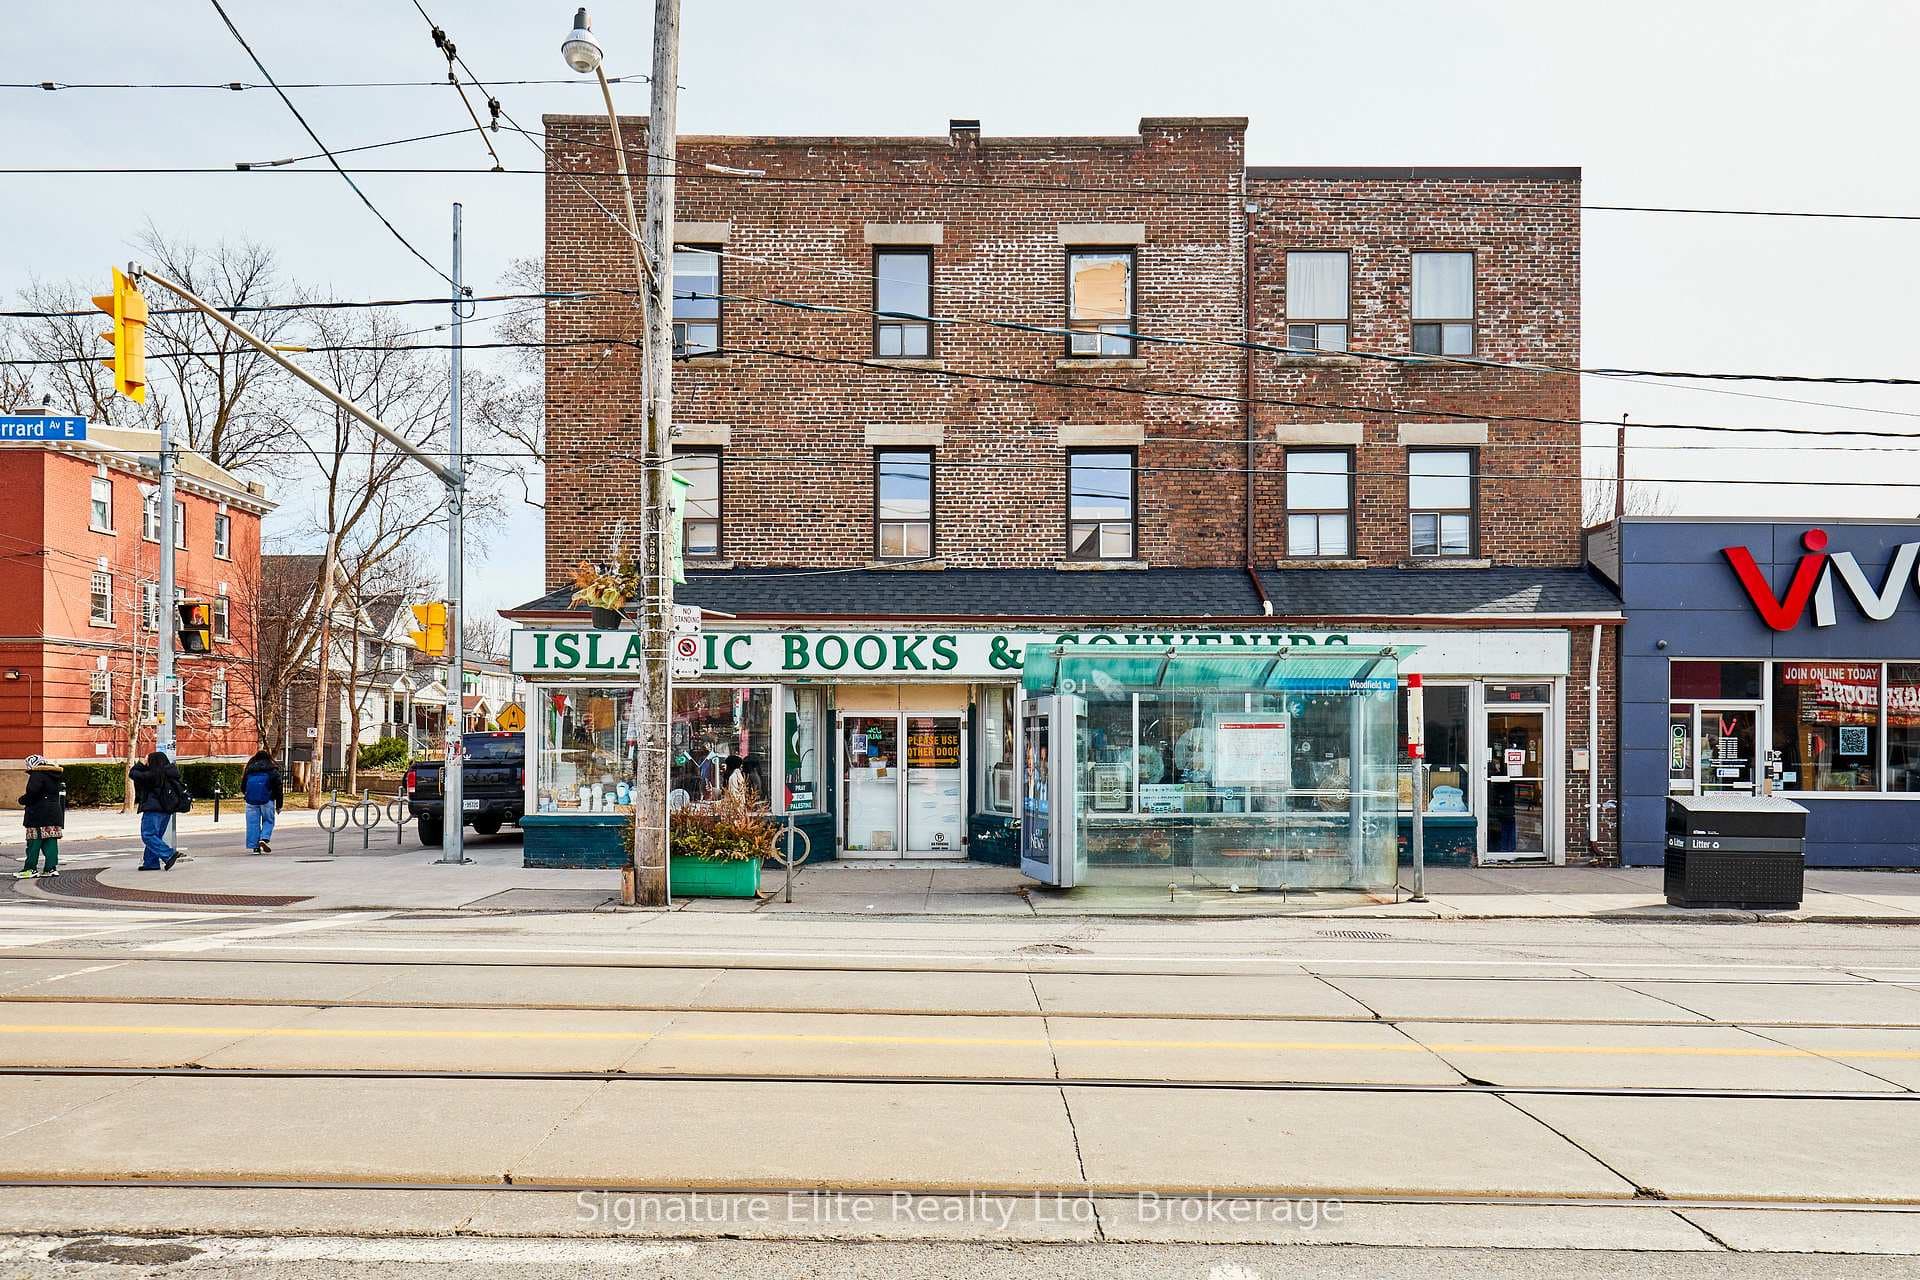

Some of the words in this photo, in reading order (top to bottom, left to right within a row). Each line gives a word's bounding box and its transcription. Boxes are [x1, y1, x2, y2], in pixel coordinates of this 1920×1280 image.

[0, 420, 44, 437] rrard
[50, 421, 60, 429] Av
[65, 421, 74, 437] E
[674, 616, 700, 624] STANDING
[533, 633, 752, 670] ISLAIC
[781, 634, 959, 671] BOOKS
[988, 635, 1025, 670] &
[1785, 667, 1808, 680] JOIN
[1810, 668, 1845, 680] ONLINE
[1847, 668, 1878, 680] TODAY
[1349, 680, 1382, 689] Woodfield
[908, 735, 939, 745] PLEASE
[941, 735, 958, 745] USE
[907, 747, 934, 757] OTHER
[936, 747, 959, 756] DOOR
[1692, 839, 1710, 849] Litter
